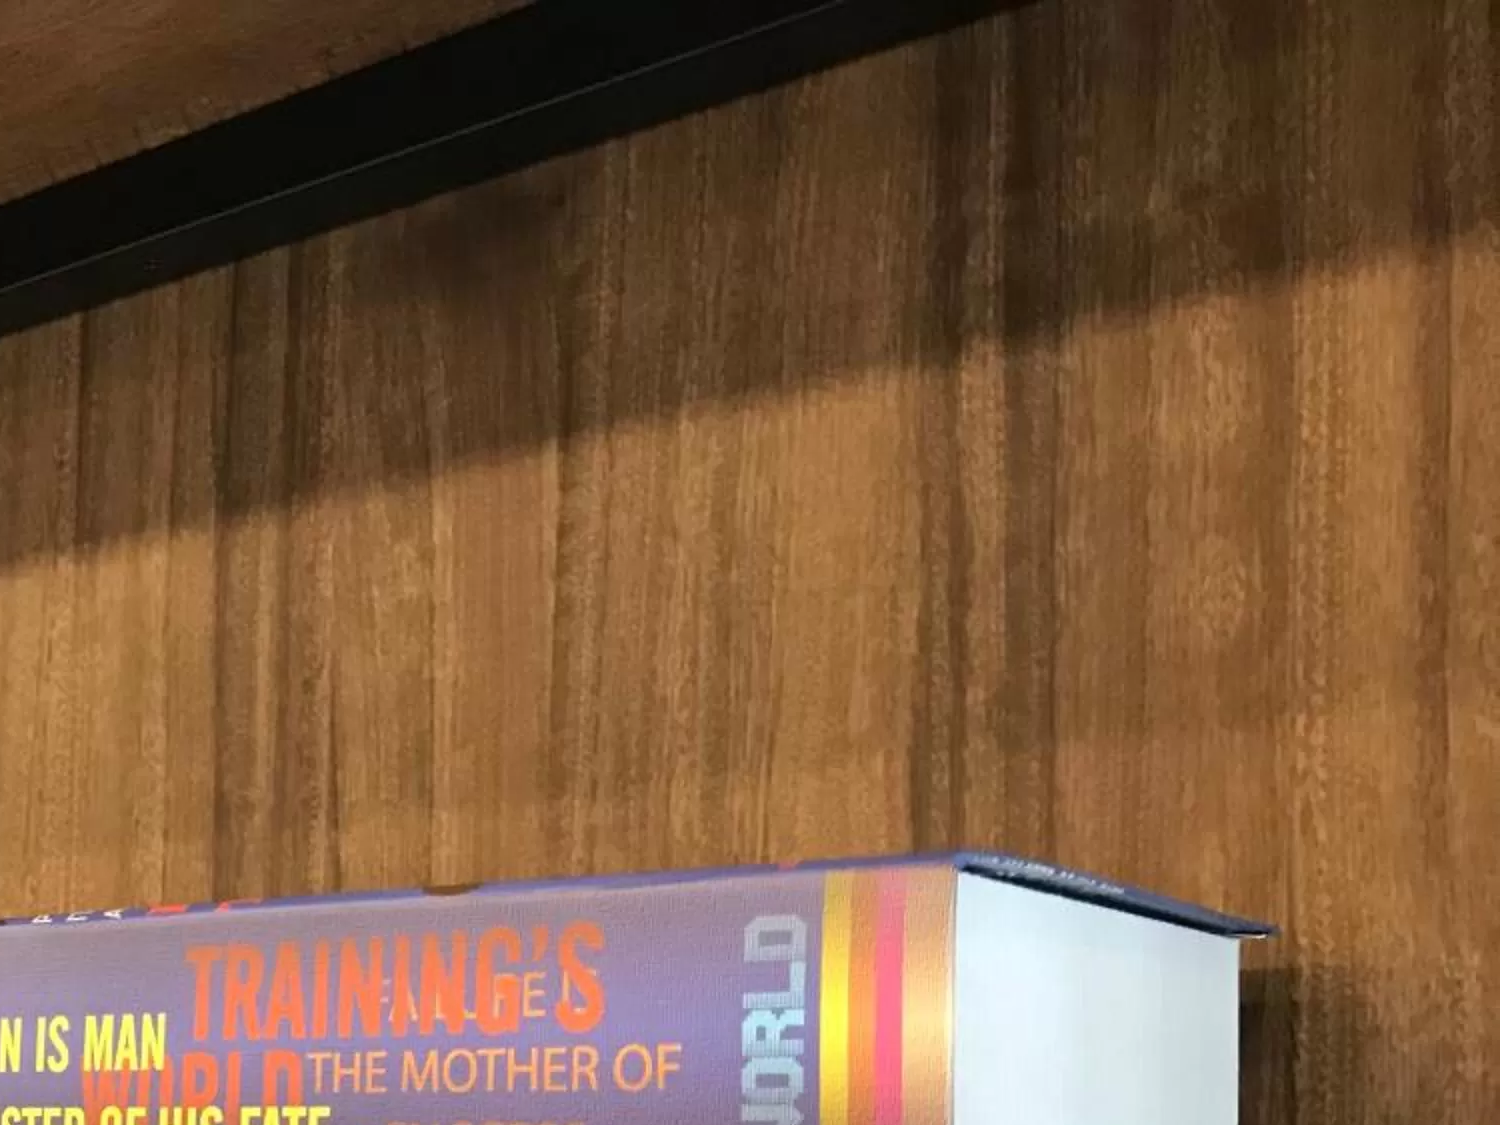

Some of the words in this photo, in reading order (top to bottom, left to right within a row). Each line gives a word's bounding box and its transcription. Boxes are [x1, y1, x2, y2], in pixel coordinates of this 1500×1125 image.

[185, 921, 606, 1040] TRAINING'S
[35, 1016, 70, 1073] IS
[83, 1013, 167, 1071] MAN
[307, 1051, 388, 1093] THE
[401, 1045, 600, 1094] MOTHER
[612, 1043, 683, 1092] OF
